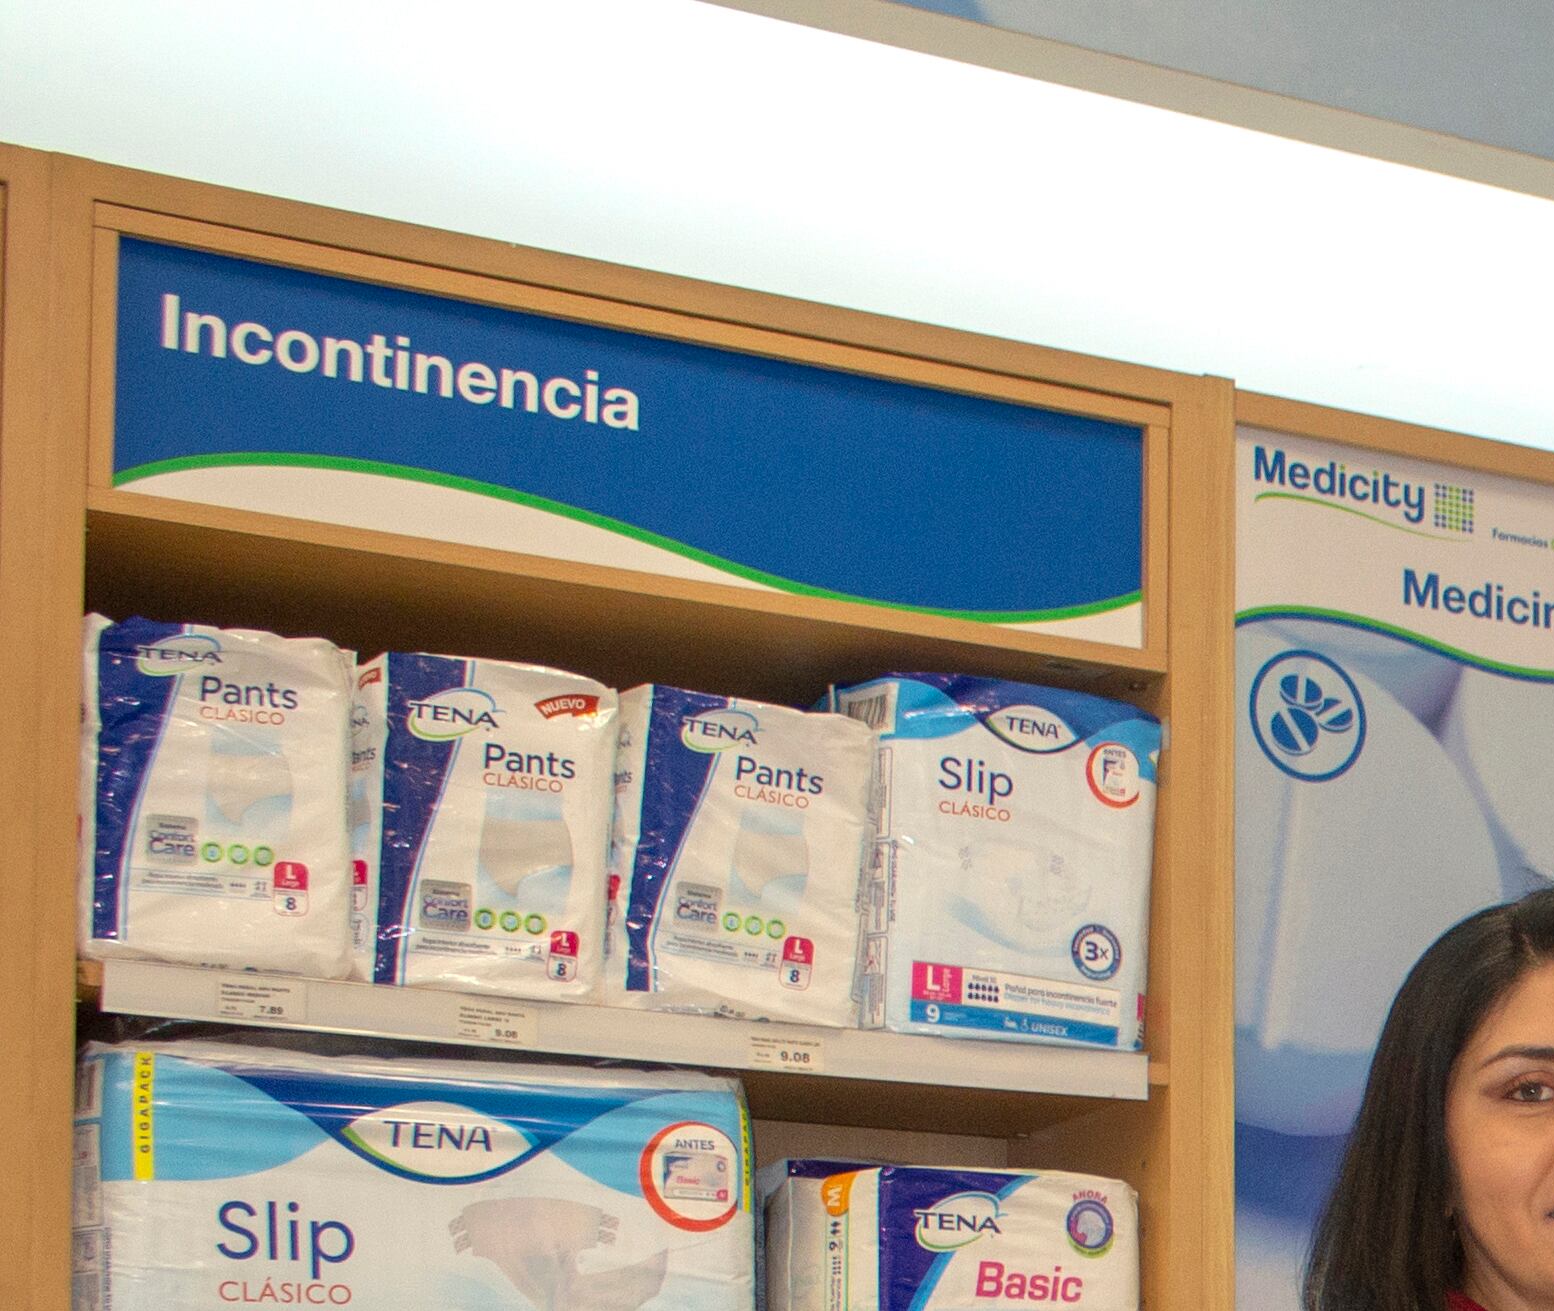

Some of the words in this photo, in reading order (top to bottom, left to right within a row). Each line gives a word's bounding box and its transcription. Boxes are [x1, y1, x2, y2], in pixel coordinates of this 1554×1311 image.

[160, 294, 640, 431] Incontinencia
[1254, 446, 1424, 523] Medicity
[141, 647, 222, 663] TENA
[201, 676, 298, 710] Pants
[411, 702, 499, 728] TENA
[540, 696, 586, 717] NUEVO
[684, 717, 757, 743] TENA
[1006, 716, 1060, 738] TENA
[484, 743, 577, 779] Pants
[736, 756, 824, 795] Pants
[939, 757, 1014, 805] Slip
[939, 800, 1011, 822] CLÁSICO
[149, 839, 195, 856] Care
[286, 865, 297, 880] L
[286, 897, 297, 910] 8
[424, 903, 468, 922] Care
[677, 903, 717, 925] Care
[793, 940, 804, 954] L
[556, 962, 567, 976] 8
[789, 969, 800, 983] 8
[926, 965, 941, 991] L
[926, 1004, 940, 1022] 9
[780, 1050, 810, 1064] 9.08
[383, 1120, 493, 1152] TENA
[675, 1137, 715, 1152] ANTES
[917, 1211, 1001, 1234] TENA
[217, 1200, 355, 1279] Slip
[219, 1279, 352, 1306] CLÁSICO
[976, 1261, 1084, 1302] Basic
